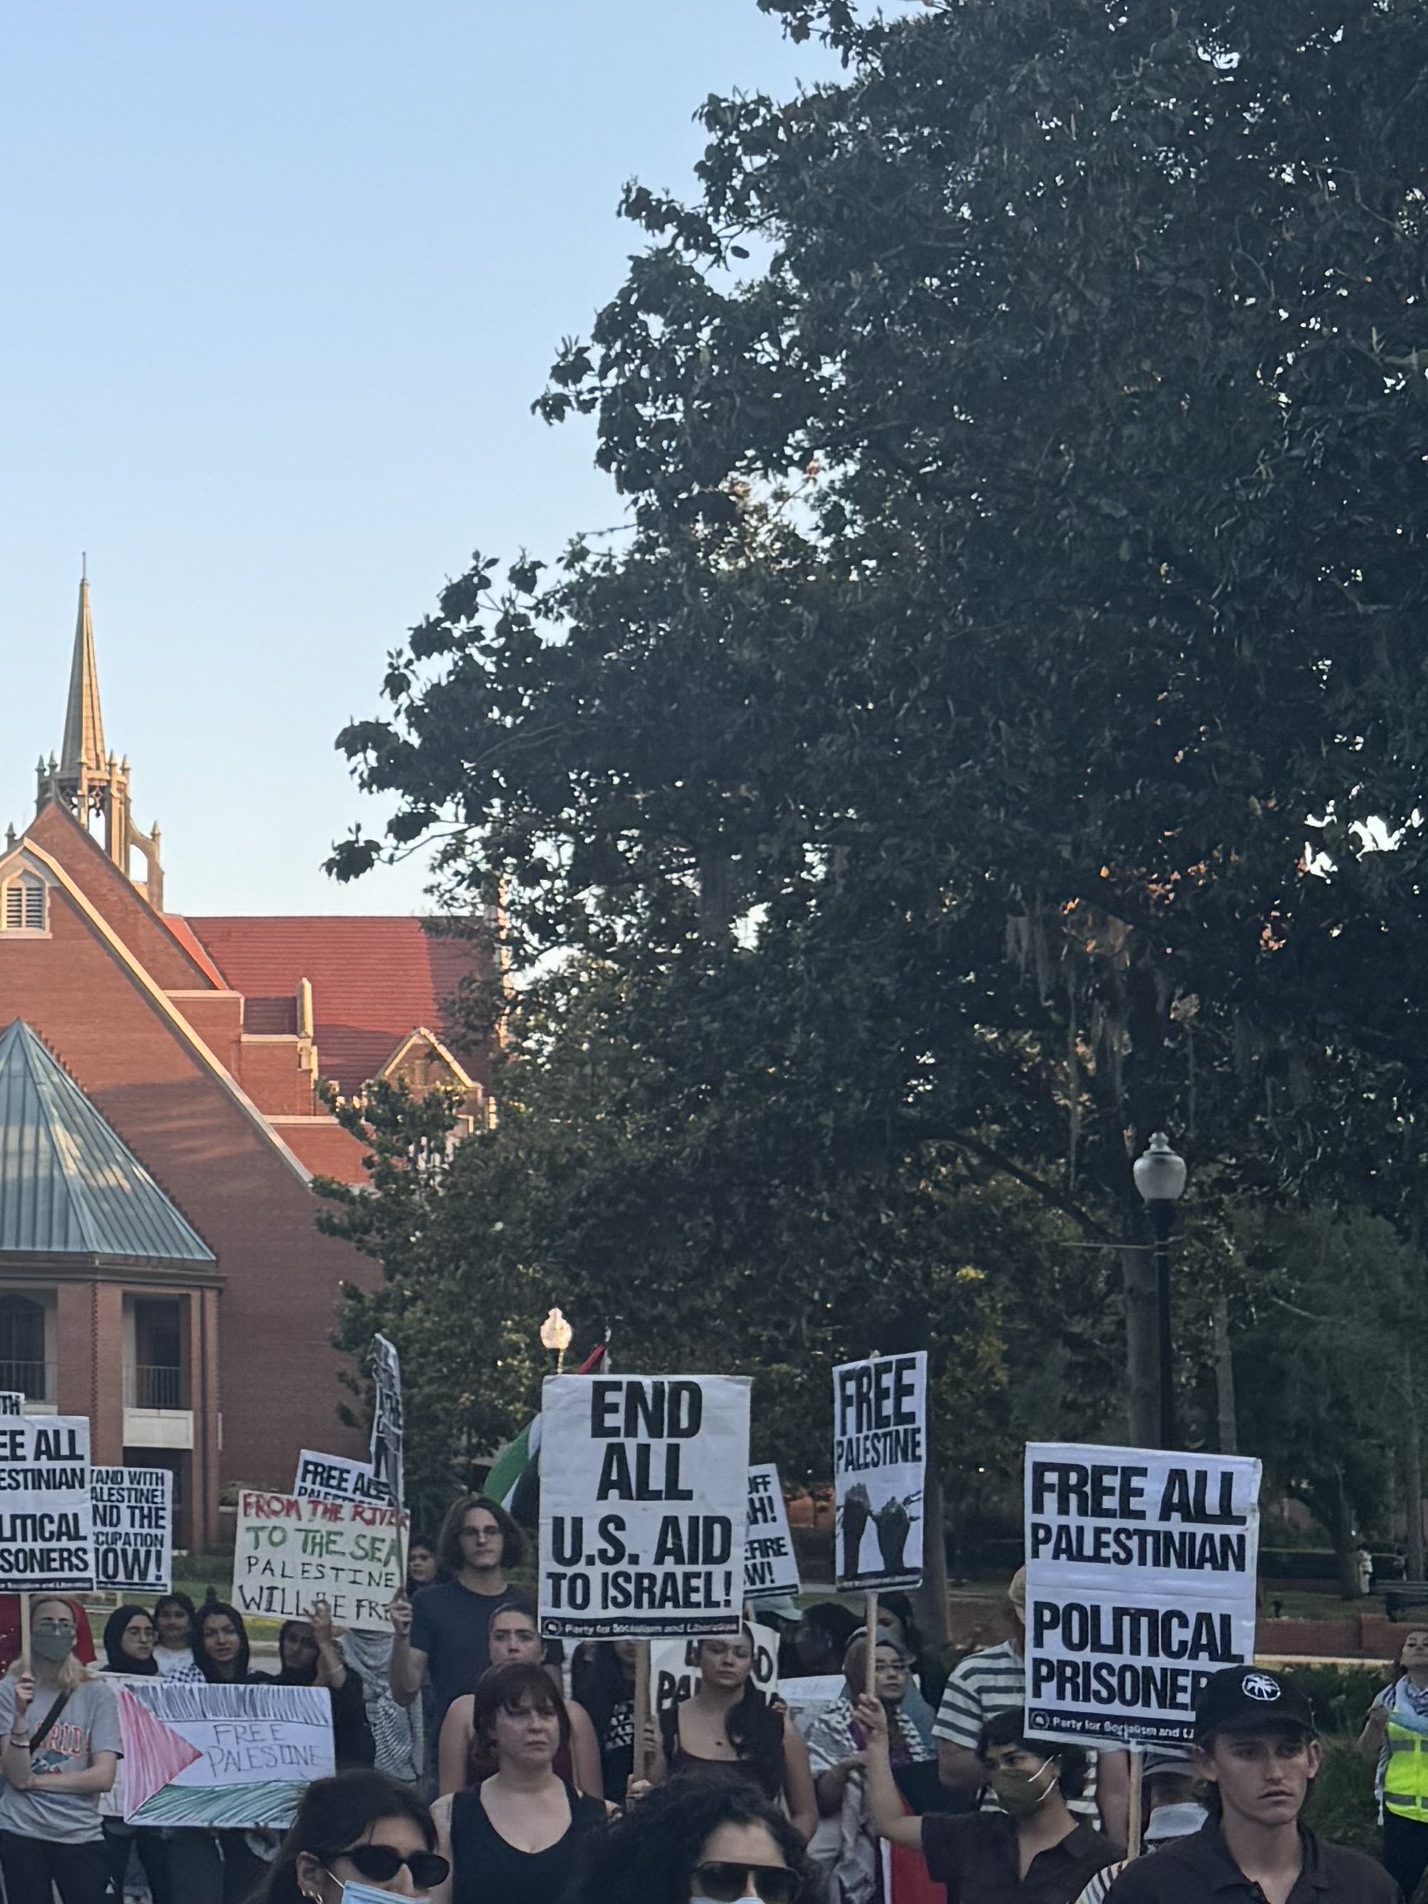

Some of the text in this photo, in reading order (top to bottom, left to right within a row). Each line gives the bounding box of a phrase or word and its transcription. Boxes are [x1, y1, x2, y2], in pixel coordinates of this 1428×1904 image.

[591, 1380, 702, 1439] END
[839, 1358, 916, 1436] FREE
[33, 1429, 84, 1461] ALL
[836, 1427, 922, 1474] PALESTINE
[129, 1470, 164, 1486] WITH
[301, 1459, 349, 1491] FREE
[596, 1442, 693, 1501] ALL
[244, 1493, 301, 1522] FROM
[307, 1499, 343, 1522] THE
[1032, 1461, 1247, 1526] FREE ALL
[127, 1506, 165, 1529] THE
[93, 1531, 164, 1548] CUPATION
[245, 1525, 288, 1550] TO
[294, 1528, 343, 1557] THE
[552, 1514, 640, 1567] U.S.
[653, 1515, 732, 1566] AID
[1030, 1522, 1246, 1572] PALESTINIAN
[96, 1549, 163, 1581] OW!
[247, 1556, 398, 1588] PALESTINE
[547, 1570, 732, 1610] TO ISRAEL!
[356, 1598, 392, 1622] FRE
[1033, 1600, 1244, 1663] POLITICAL
[1032, 1658, 1214, 1711] PRISONE
[213, 1723, 288, 1746] FREE
[1053, 1716, 1082, 1730] Party
[1085, 1718, 1101, 1730] for
[1159, 1726, 1179, 1738] and
[207, 1744, 324, 1778] PALESTINE
